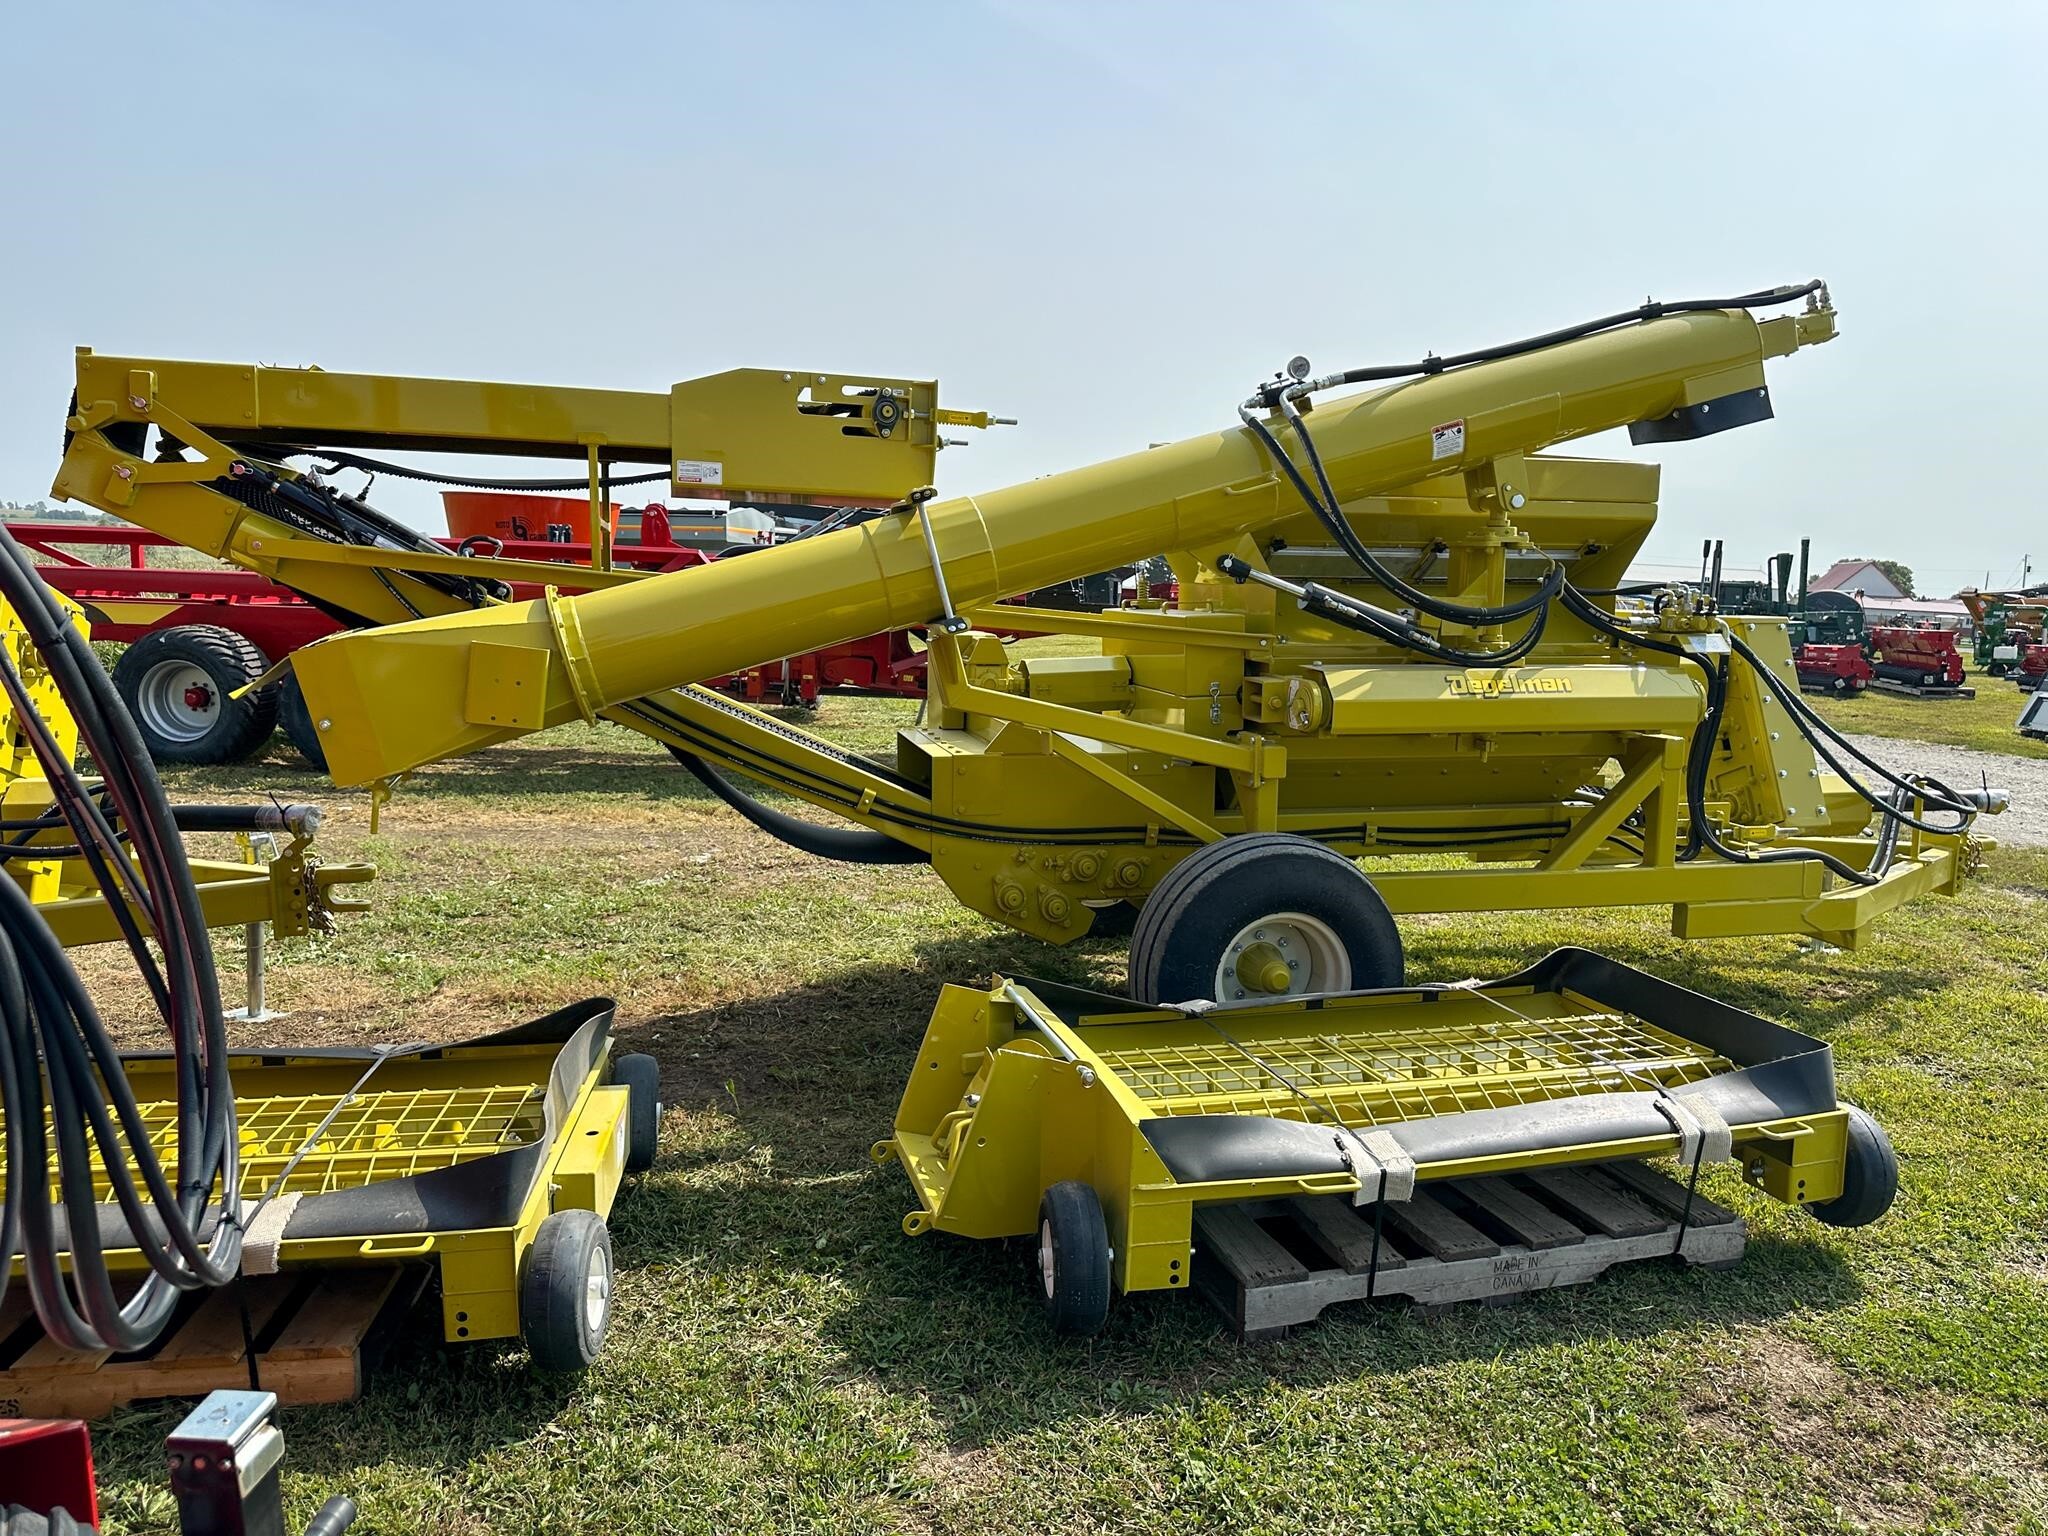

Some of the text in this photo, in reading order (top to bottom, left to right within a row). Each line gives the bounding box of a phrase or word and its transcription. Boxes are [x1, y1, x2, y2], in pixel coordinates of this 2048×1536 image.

[1444, 673, 1572, 699] Degelman
[1493, 1255, 1539, 1273] MADE IN
[1492, 1271, 1540, 1290] CANADA
